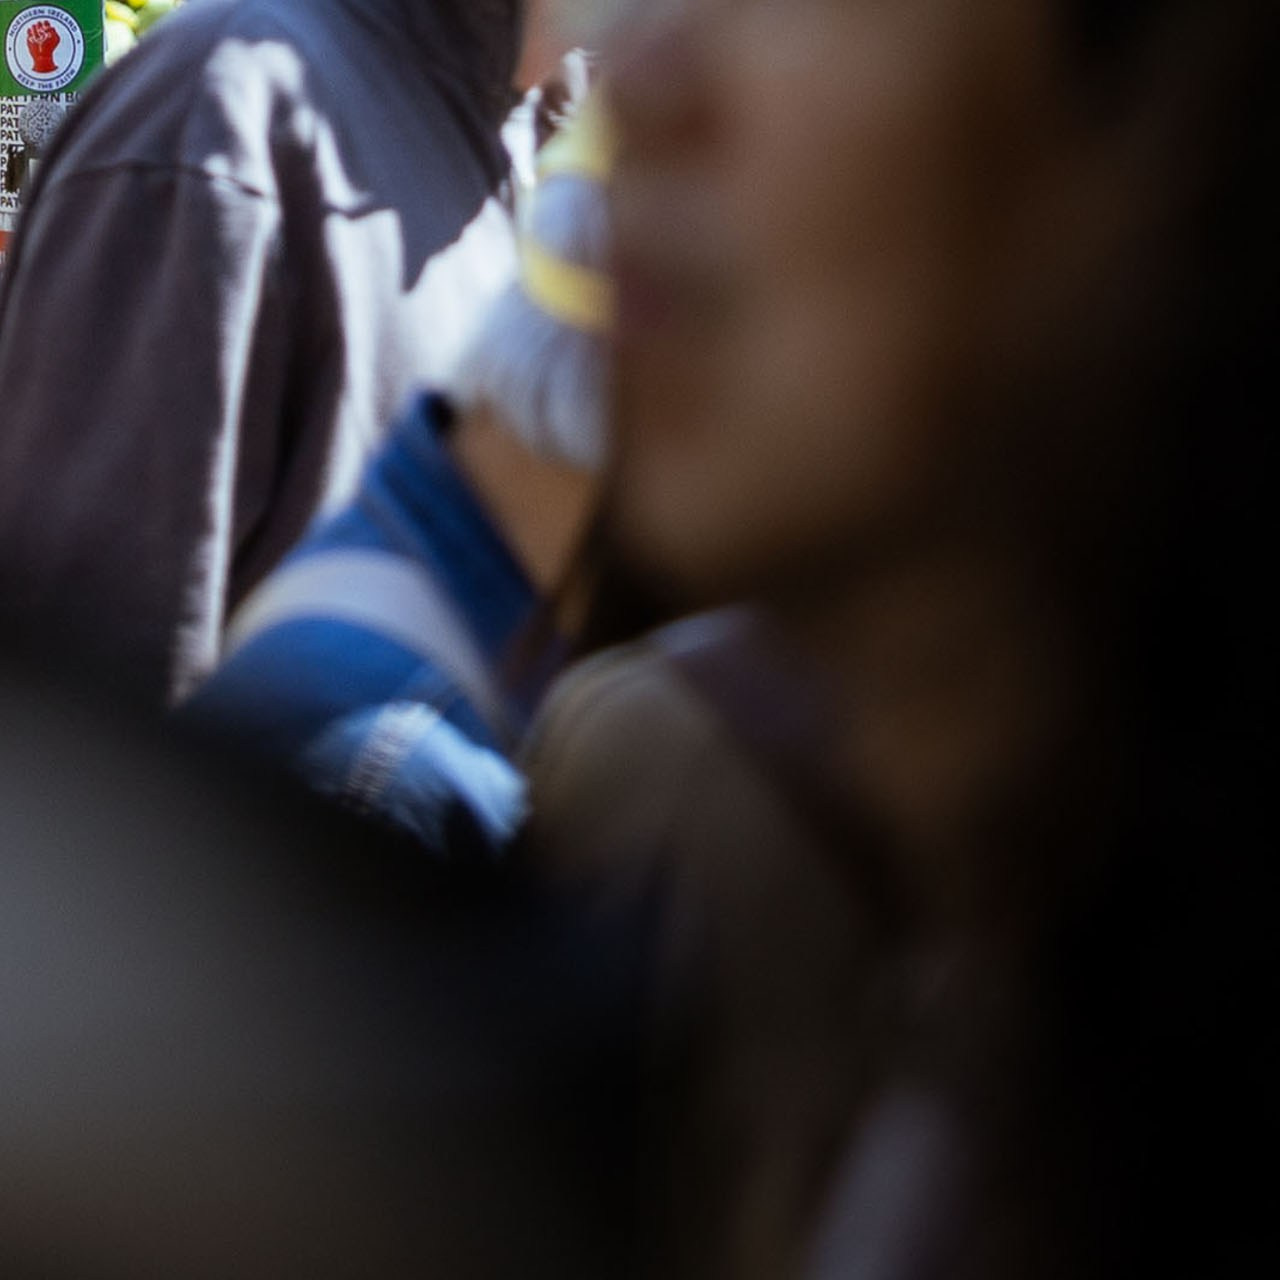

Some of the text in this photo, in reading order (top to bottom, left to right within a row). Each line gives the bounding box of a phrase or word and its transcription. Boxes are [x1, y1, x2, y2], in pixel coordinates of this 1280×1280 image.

[47, 8, 78, 33] IRELAND
[17, 69, 76, 90] KEEP THE FAITH
